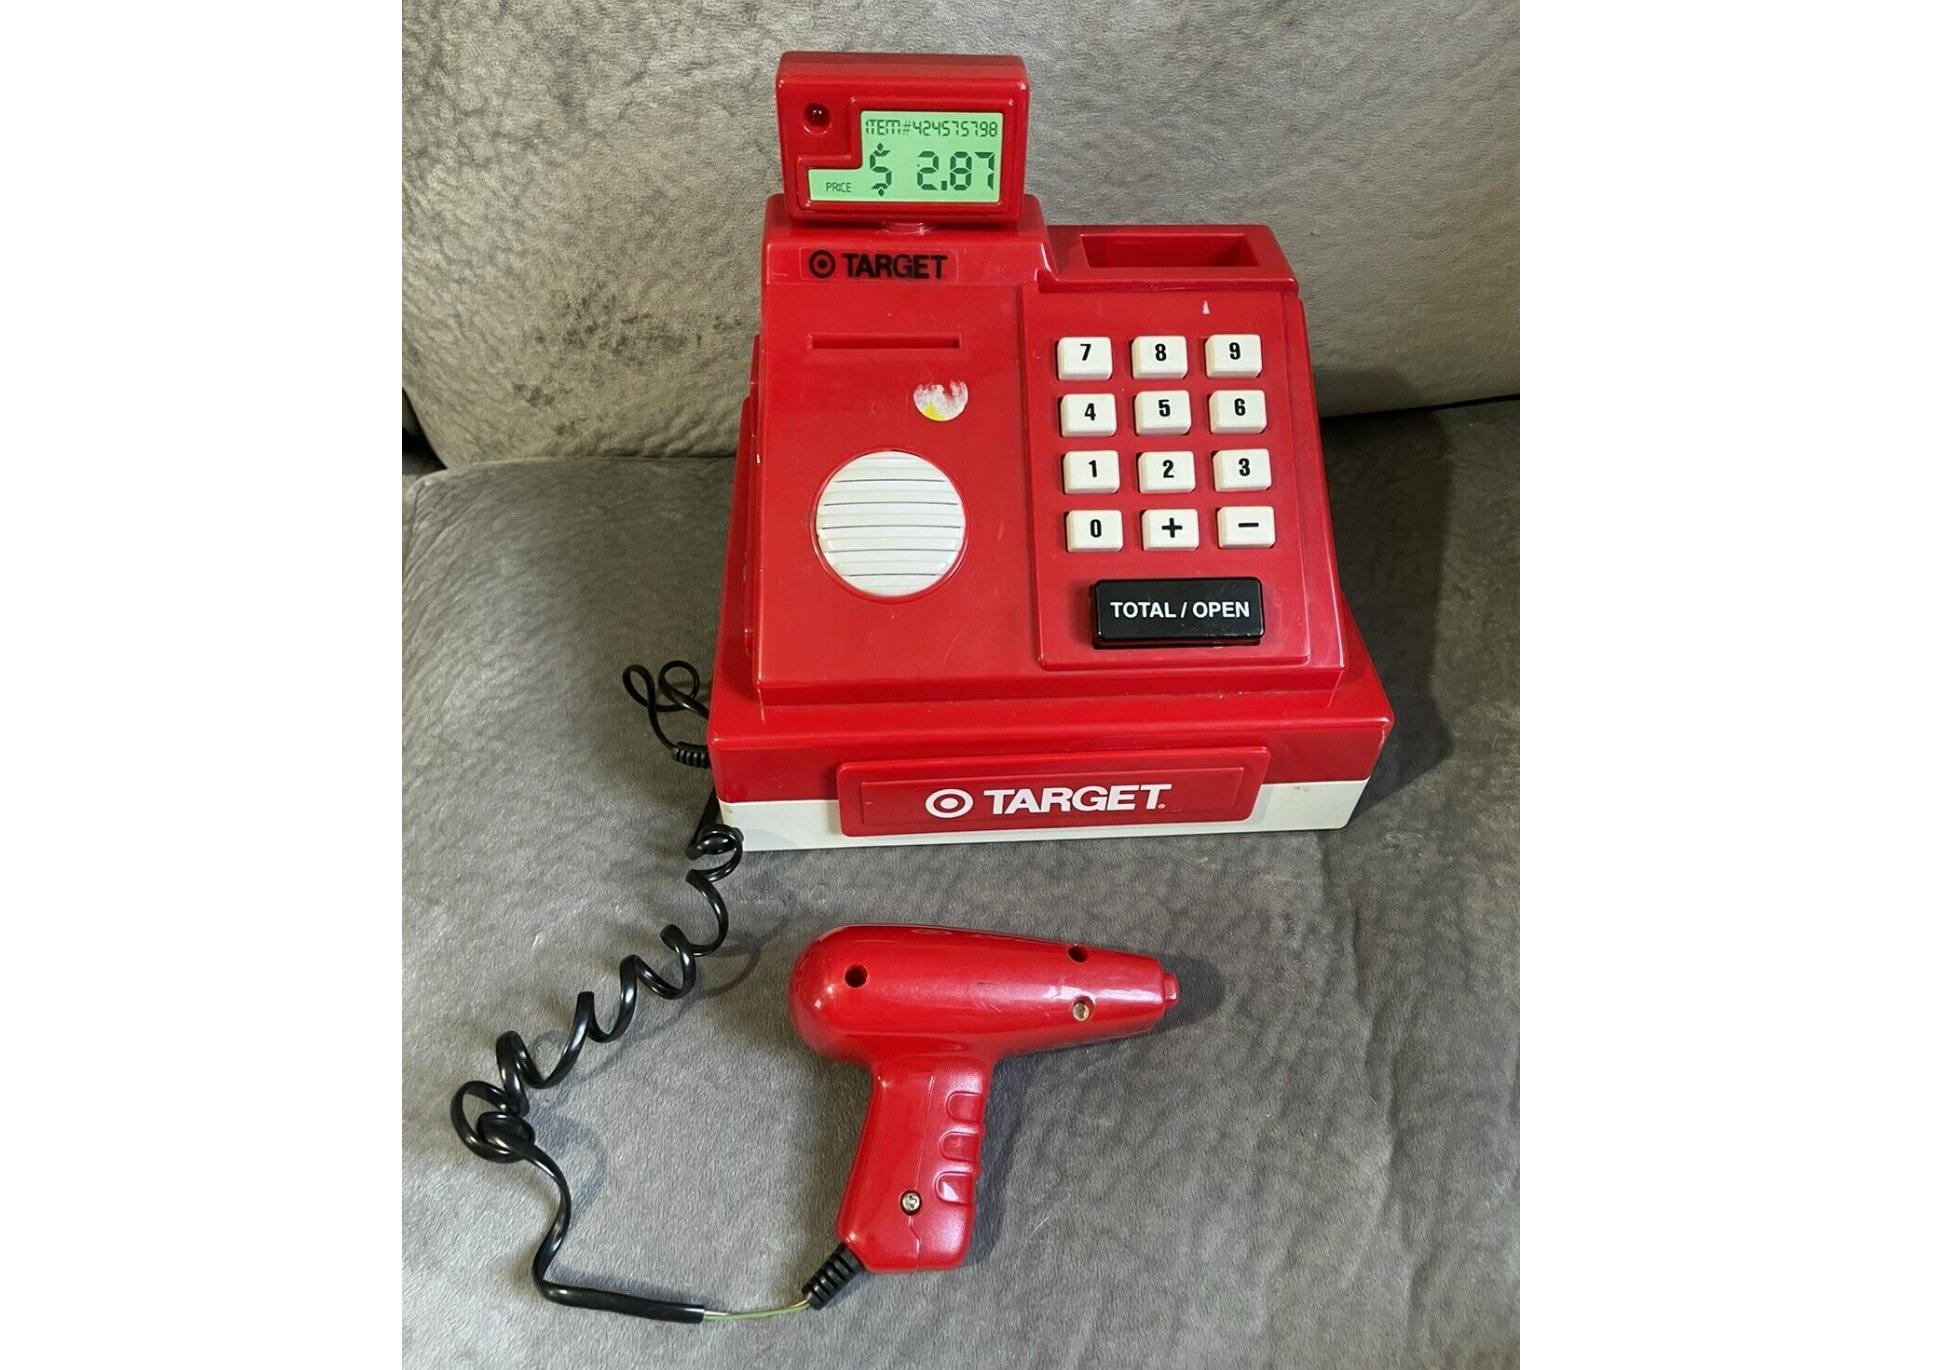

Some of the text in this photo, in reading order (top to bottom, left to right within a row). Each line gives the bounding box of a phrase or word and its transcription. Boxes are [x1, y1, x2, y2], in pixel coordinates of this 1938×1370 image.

[917, 151, 995, 191] 2.87
[825, 181, 852, 193] PRICE
[842, 253, 948, 279] TARGET
[1079, 341, 1242, 362] 7 8 9
[1084, 397, 1247, 422] 4 5 6
[1088, 457, 1251, 479] 1 2 3
[1089, 518, 1101, 539] 0
[1110, 601, 1250, 618] TOTAL / OPEN
